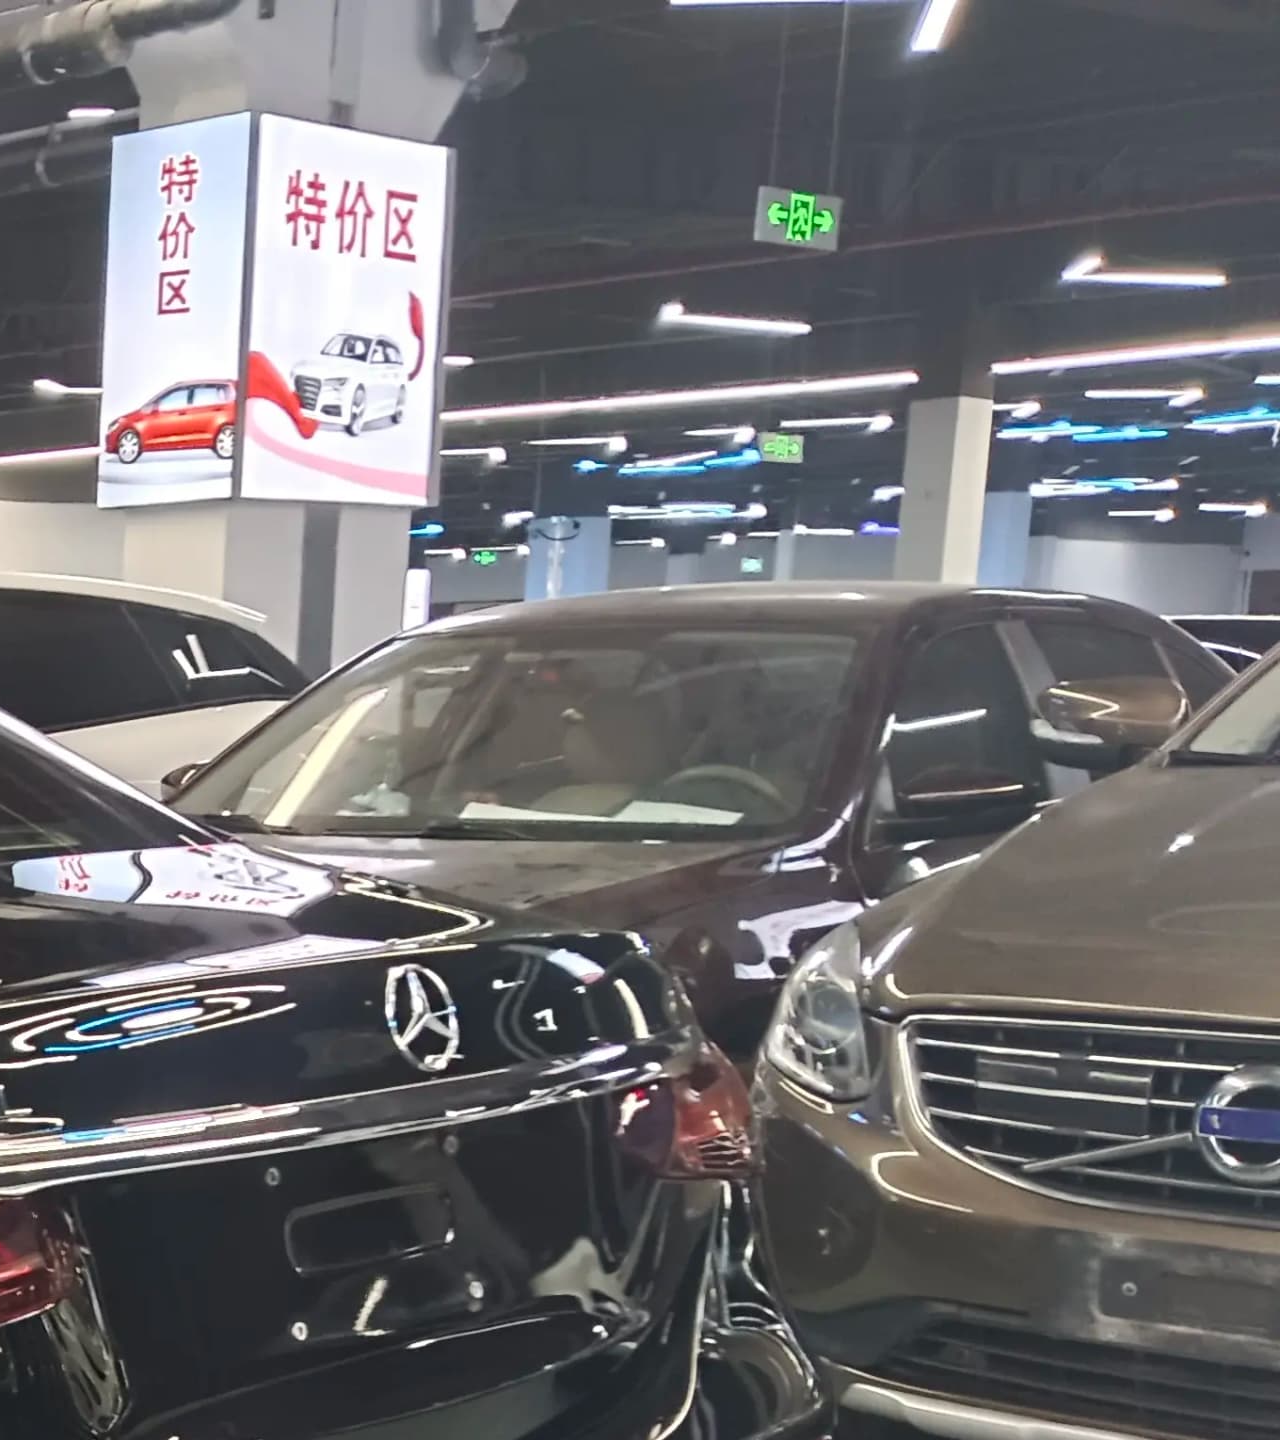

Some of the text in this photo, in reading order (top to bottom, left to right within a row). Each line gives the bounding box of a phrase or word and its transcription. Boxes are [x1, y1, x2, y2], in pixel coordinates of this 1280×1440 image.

[157, 154, 200, 316] 特价区
[285, 169, 419, 263] 特价区
